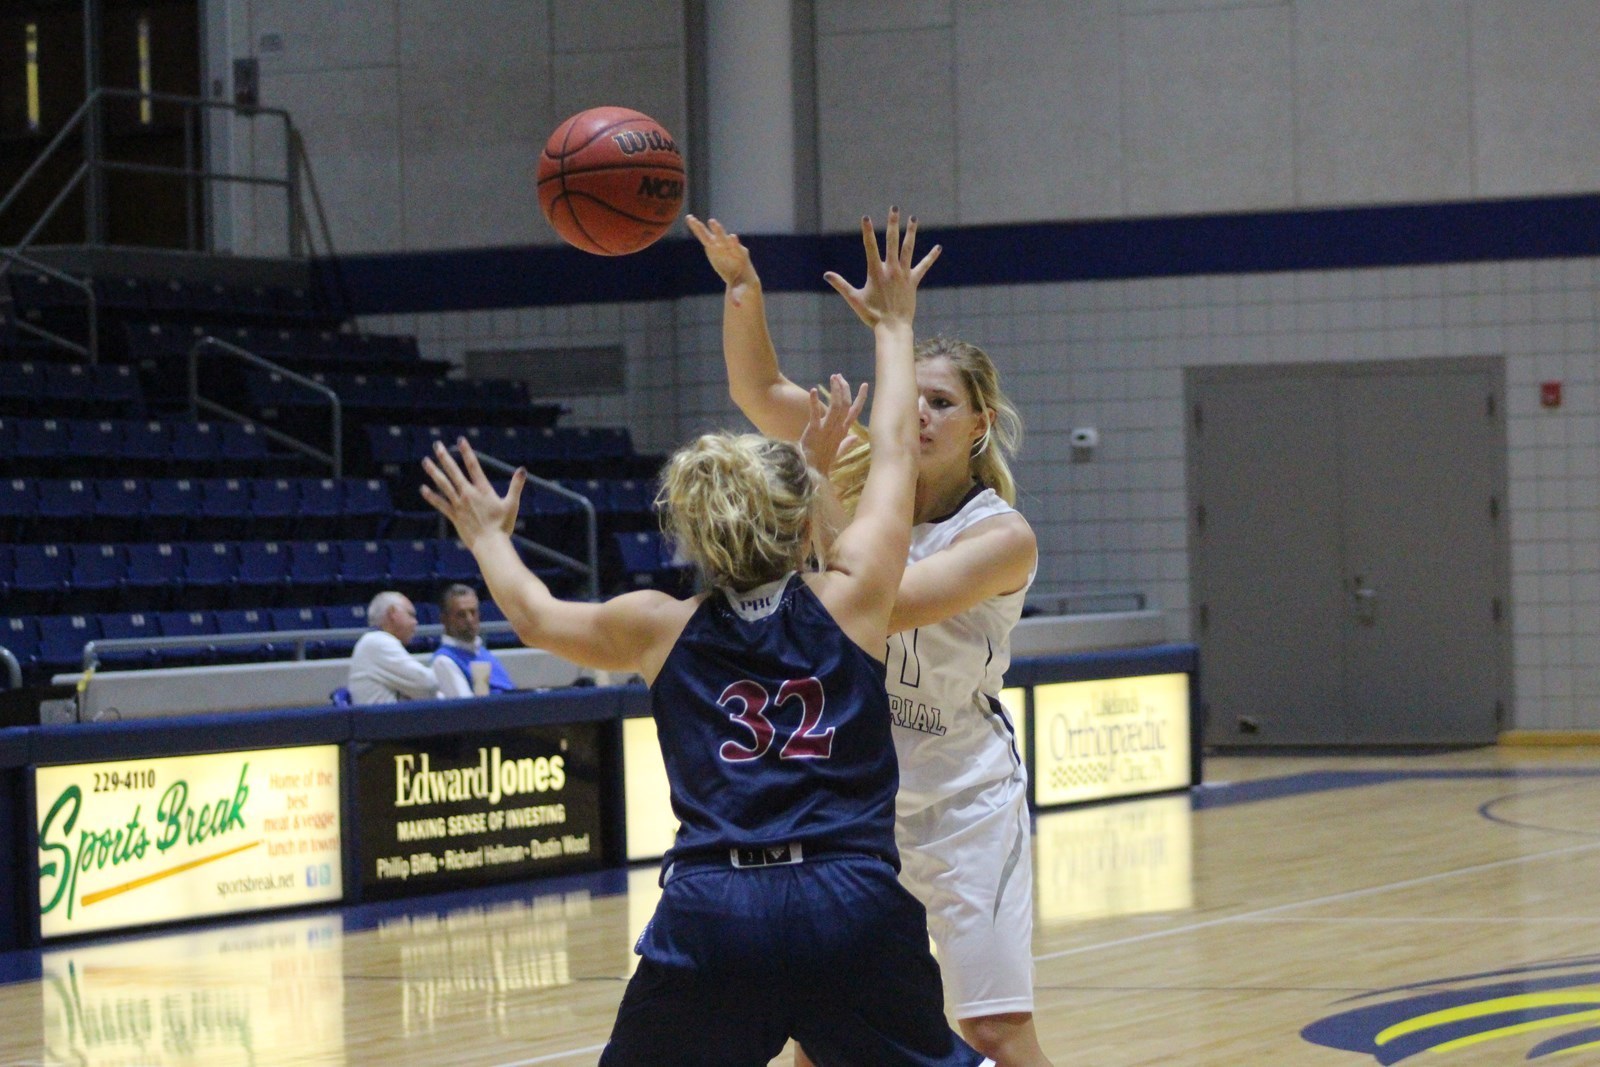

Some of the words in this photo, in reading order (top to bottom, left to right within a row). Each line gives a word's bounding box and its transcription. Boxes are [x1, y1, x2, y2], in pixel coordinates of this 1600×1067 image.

[716, 676, 836, 763] 32
[92, 769, 156, 792] 229-4110
[38, 784, 150, 921] Sports
[156, 761, 250, 852] Break
[396, 816, 447, 842] MAKING
[447, 812, 488, 836] SENSE
[488, 810, 505, 832] OF
[505, 803, 567, 829] INVESTING
